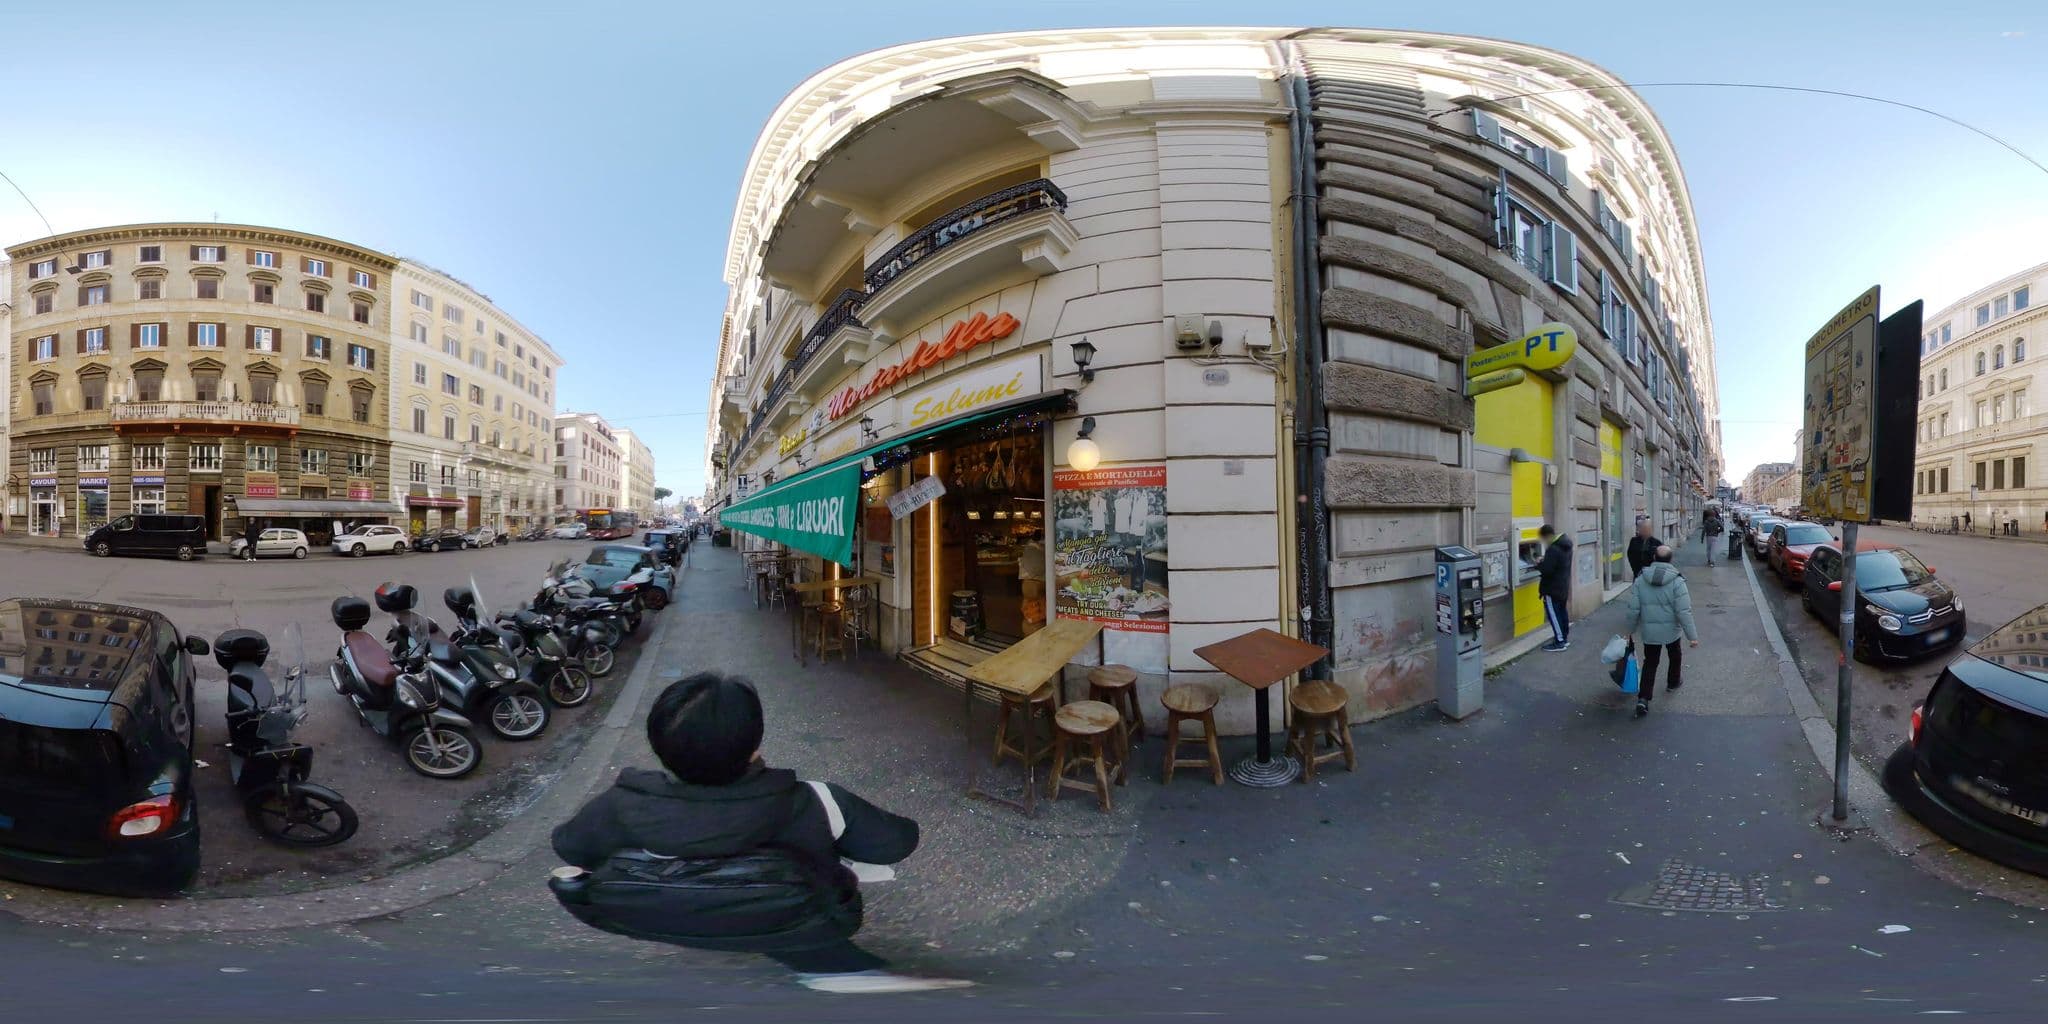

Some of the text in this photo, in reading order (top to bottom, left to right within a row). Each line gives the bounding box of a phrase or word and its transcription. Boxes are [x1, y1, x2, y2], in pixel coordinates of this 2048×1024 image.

[1807, 294, 1872, 351] PARCOMETRO
[1525, 331, 1565, 357] PT
[829, 311, 1021, 421] Mortadella
[909, 371, 1024, 428] Salumi
[796, 495, 845, 537] LIQUORI
[1438, 565, 1446, 583] P
[1079, 607, 1094, 616] AND
